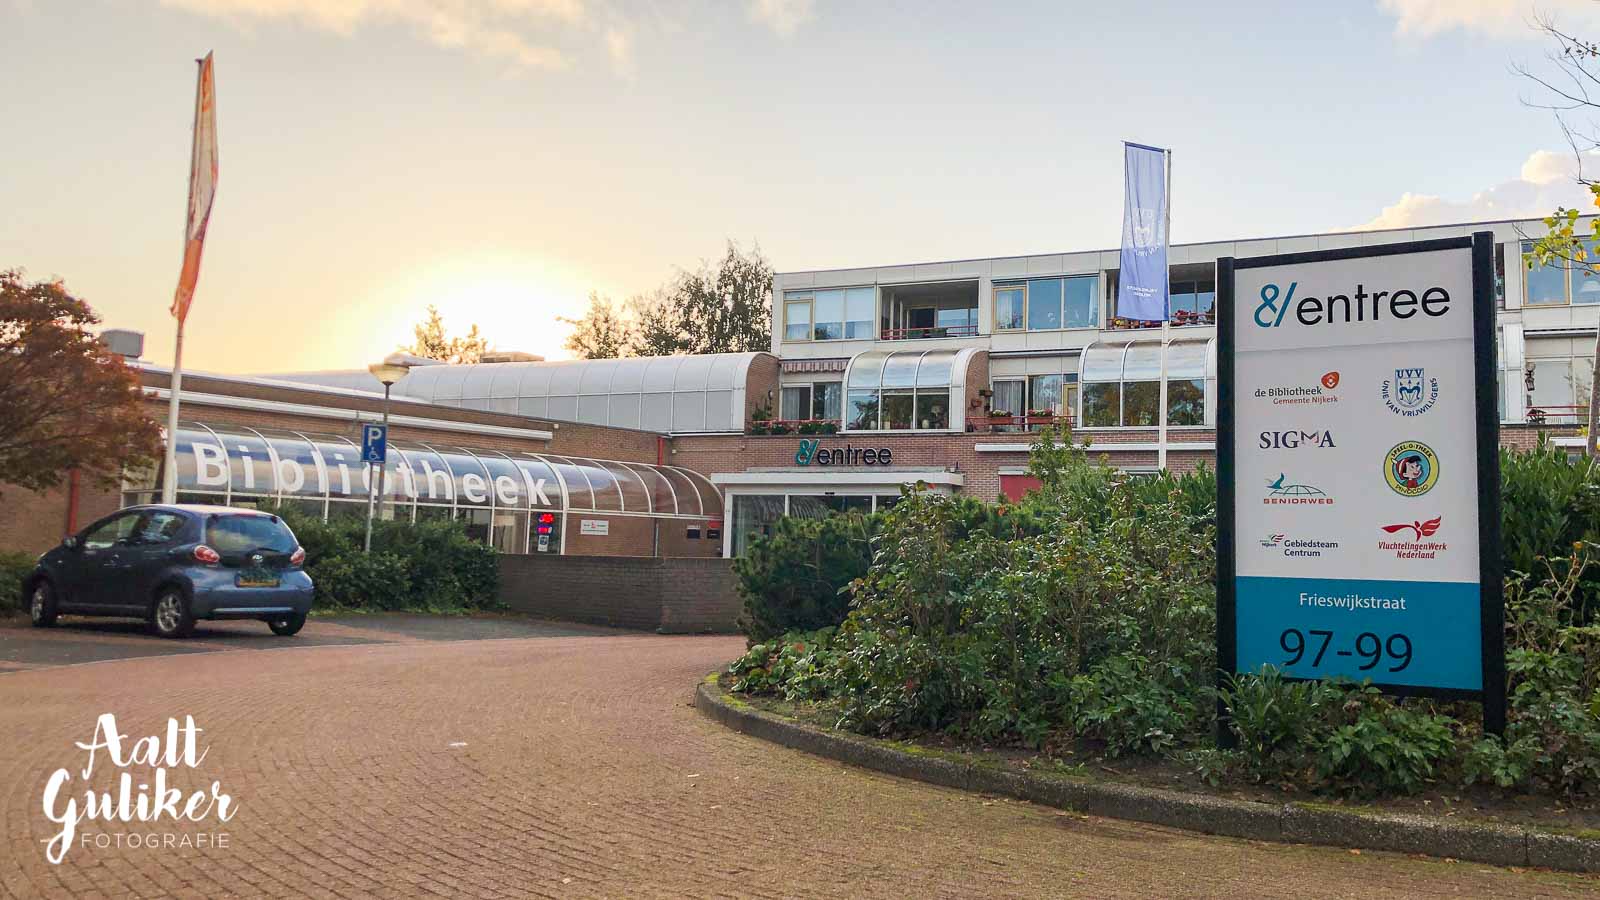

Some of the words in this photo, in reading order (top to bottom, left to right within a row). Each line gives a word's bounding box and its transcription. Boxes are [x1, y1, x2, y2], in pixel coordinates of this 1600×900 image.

[1396, 369, 1422, 379] UVV
[1254, 388, 1267, 398] de
[1268, 386, 1323, 398] Bibliotheek
[1382, 380, 1391, 400] UNIE
[1402, 377, 1439, 417] VRIJWILLIGERS
[1273, 396, 1311, 405] Gemeente
[1311, 395, 1339, 405] Nijkerk
[1386, 400, 1401, 414] VAN
[367, 427, 382, 447] P
[1259, 430, 1336, 449] SIGMA
[191, 441, 553, 507] Bibliotheek
[1284, 539, 1338, 549] Gebiedsteam
[1378, 541, 1447, 552] VluchtelingenWerk
[1284, 549, 1321, 557] Centrum
[1396, 550, 1435, 560] Nederland
[1300, 592, 1406, 611] Frieswijkstraat
[1279, 627, 1413, 673] 97-99
